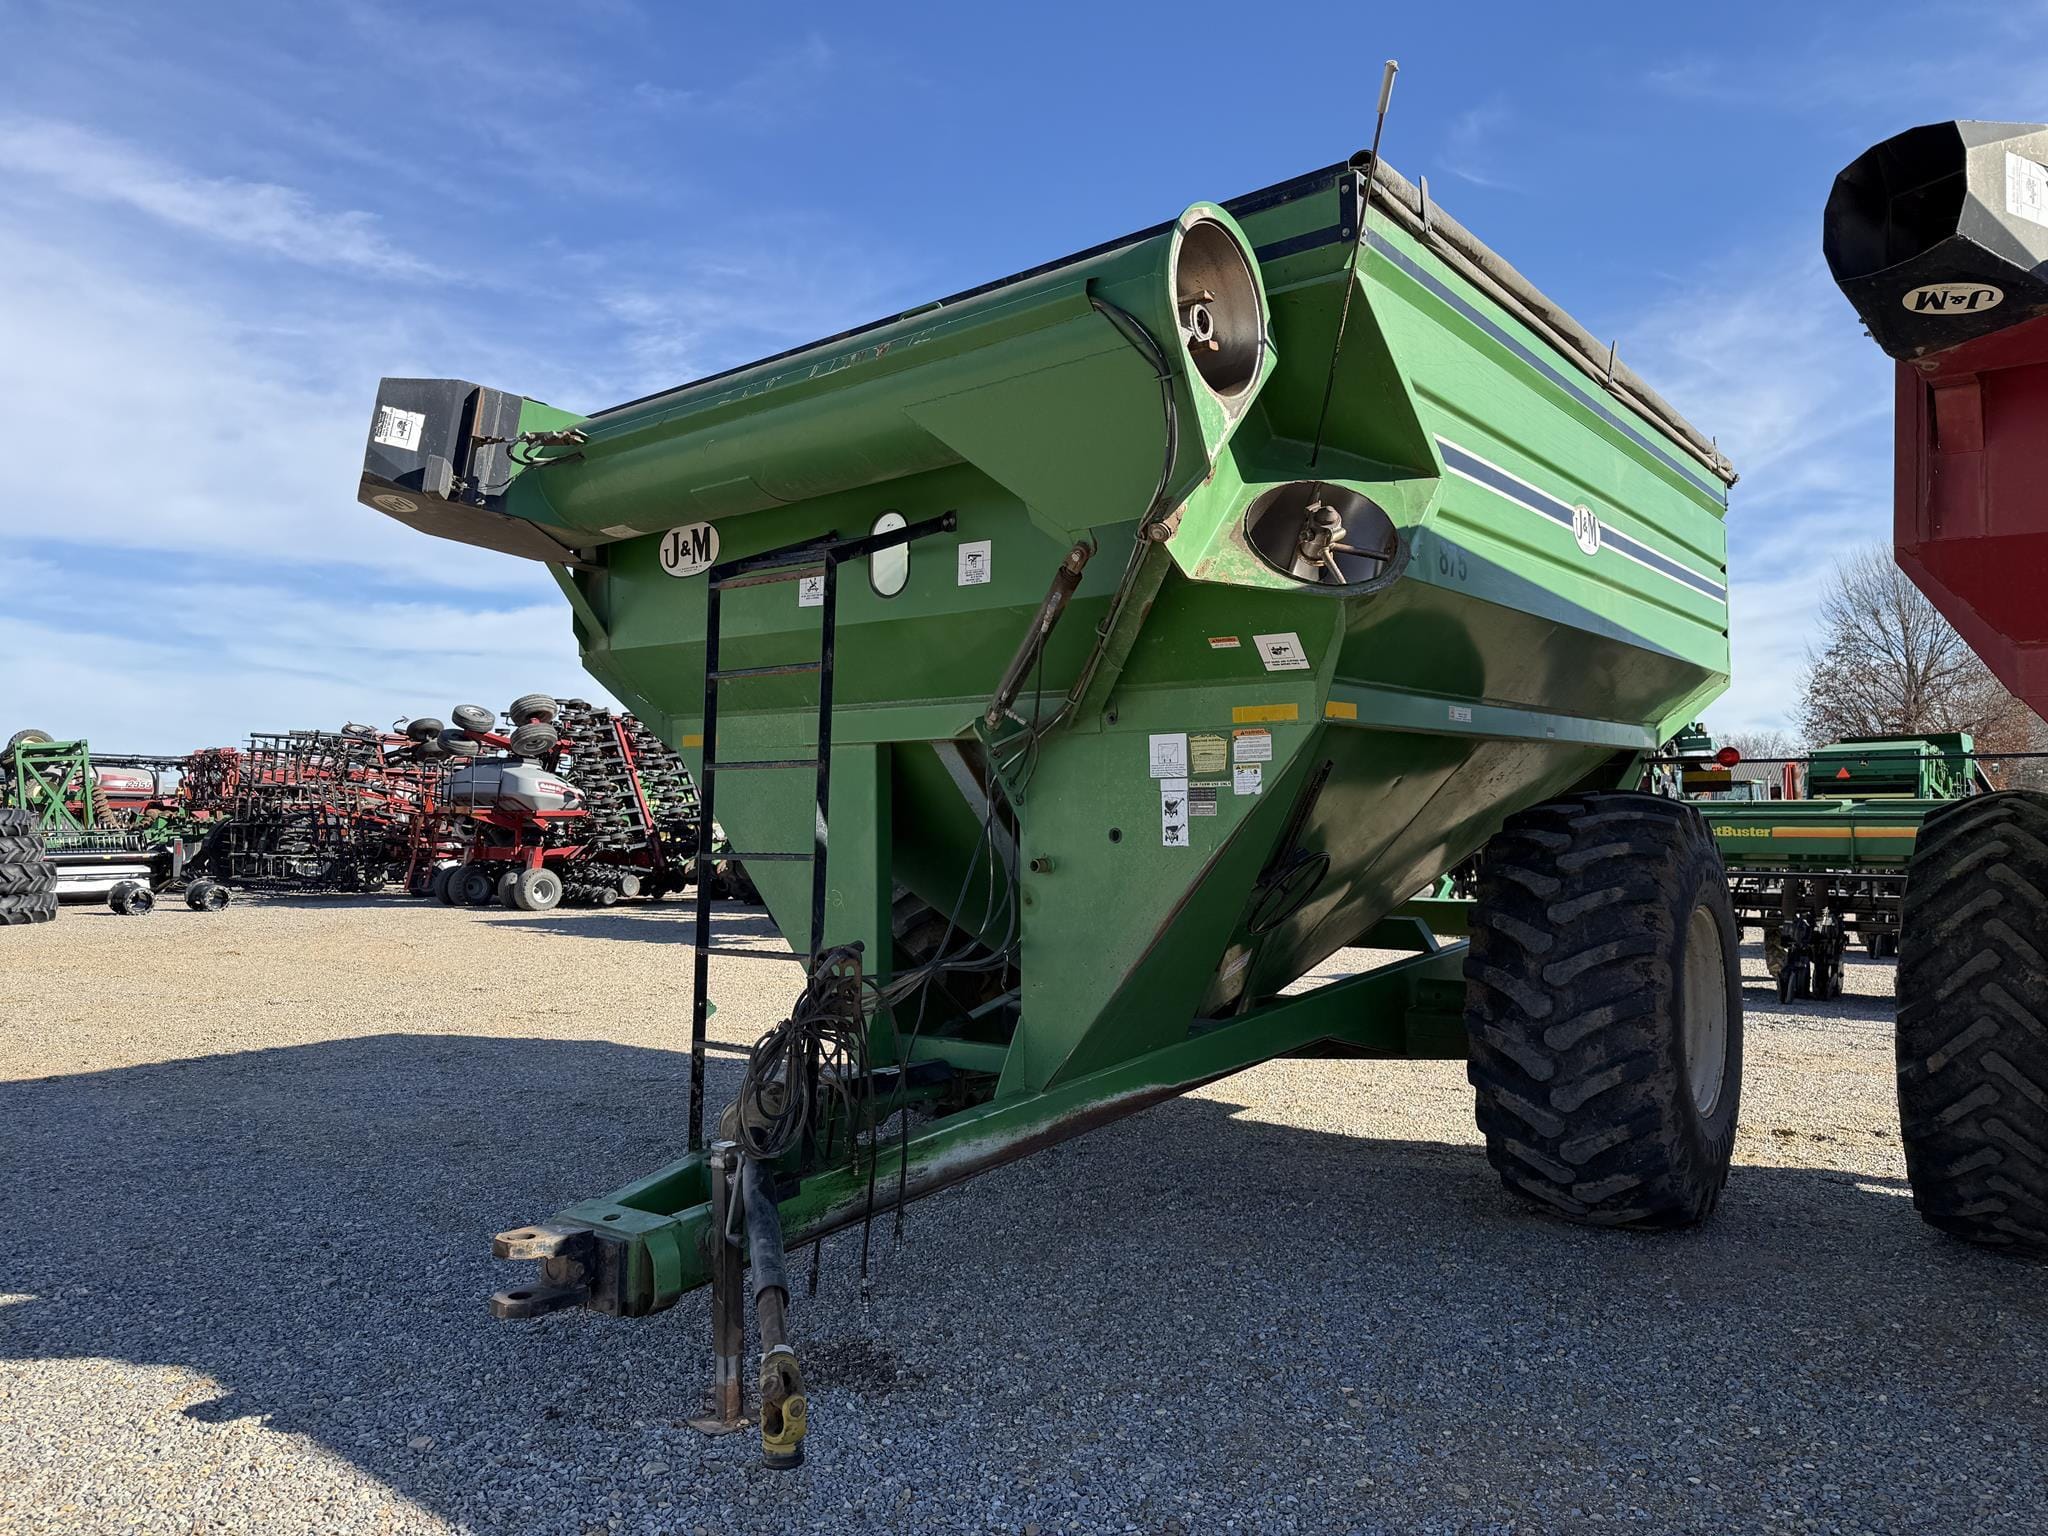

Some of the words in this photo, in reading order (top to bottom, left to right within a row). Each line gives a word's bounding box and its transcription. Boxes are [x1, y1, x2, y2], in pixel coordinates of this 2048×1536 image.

[1913, 289, 1995, 311] J&M
[1574, 509, 1598, 547] J&M
[663, 526, 712, 569] J&M
